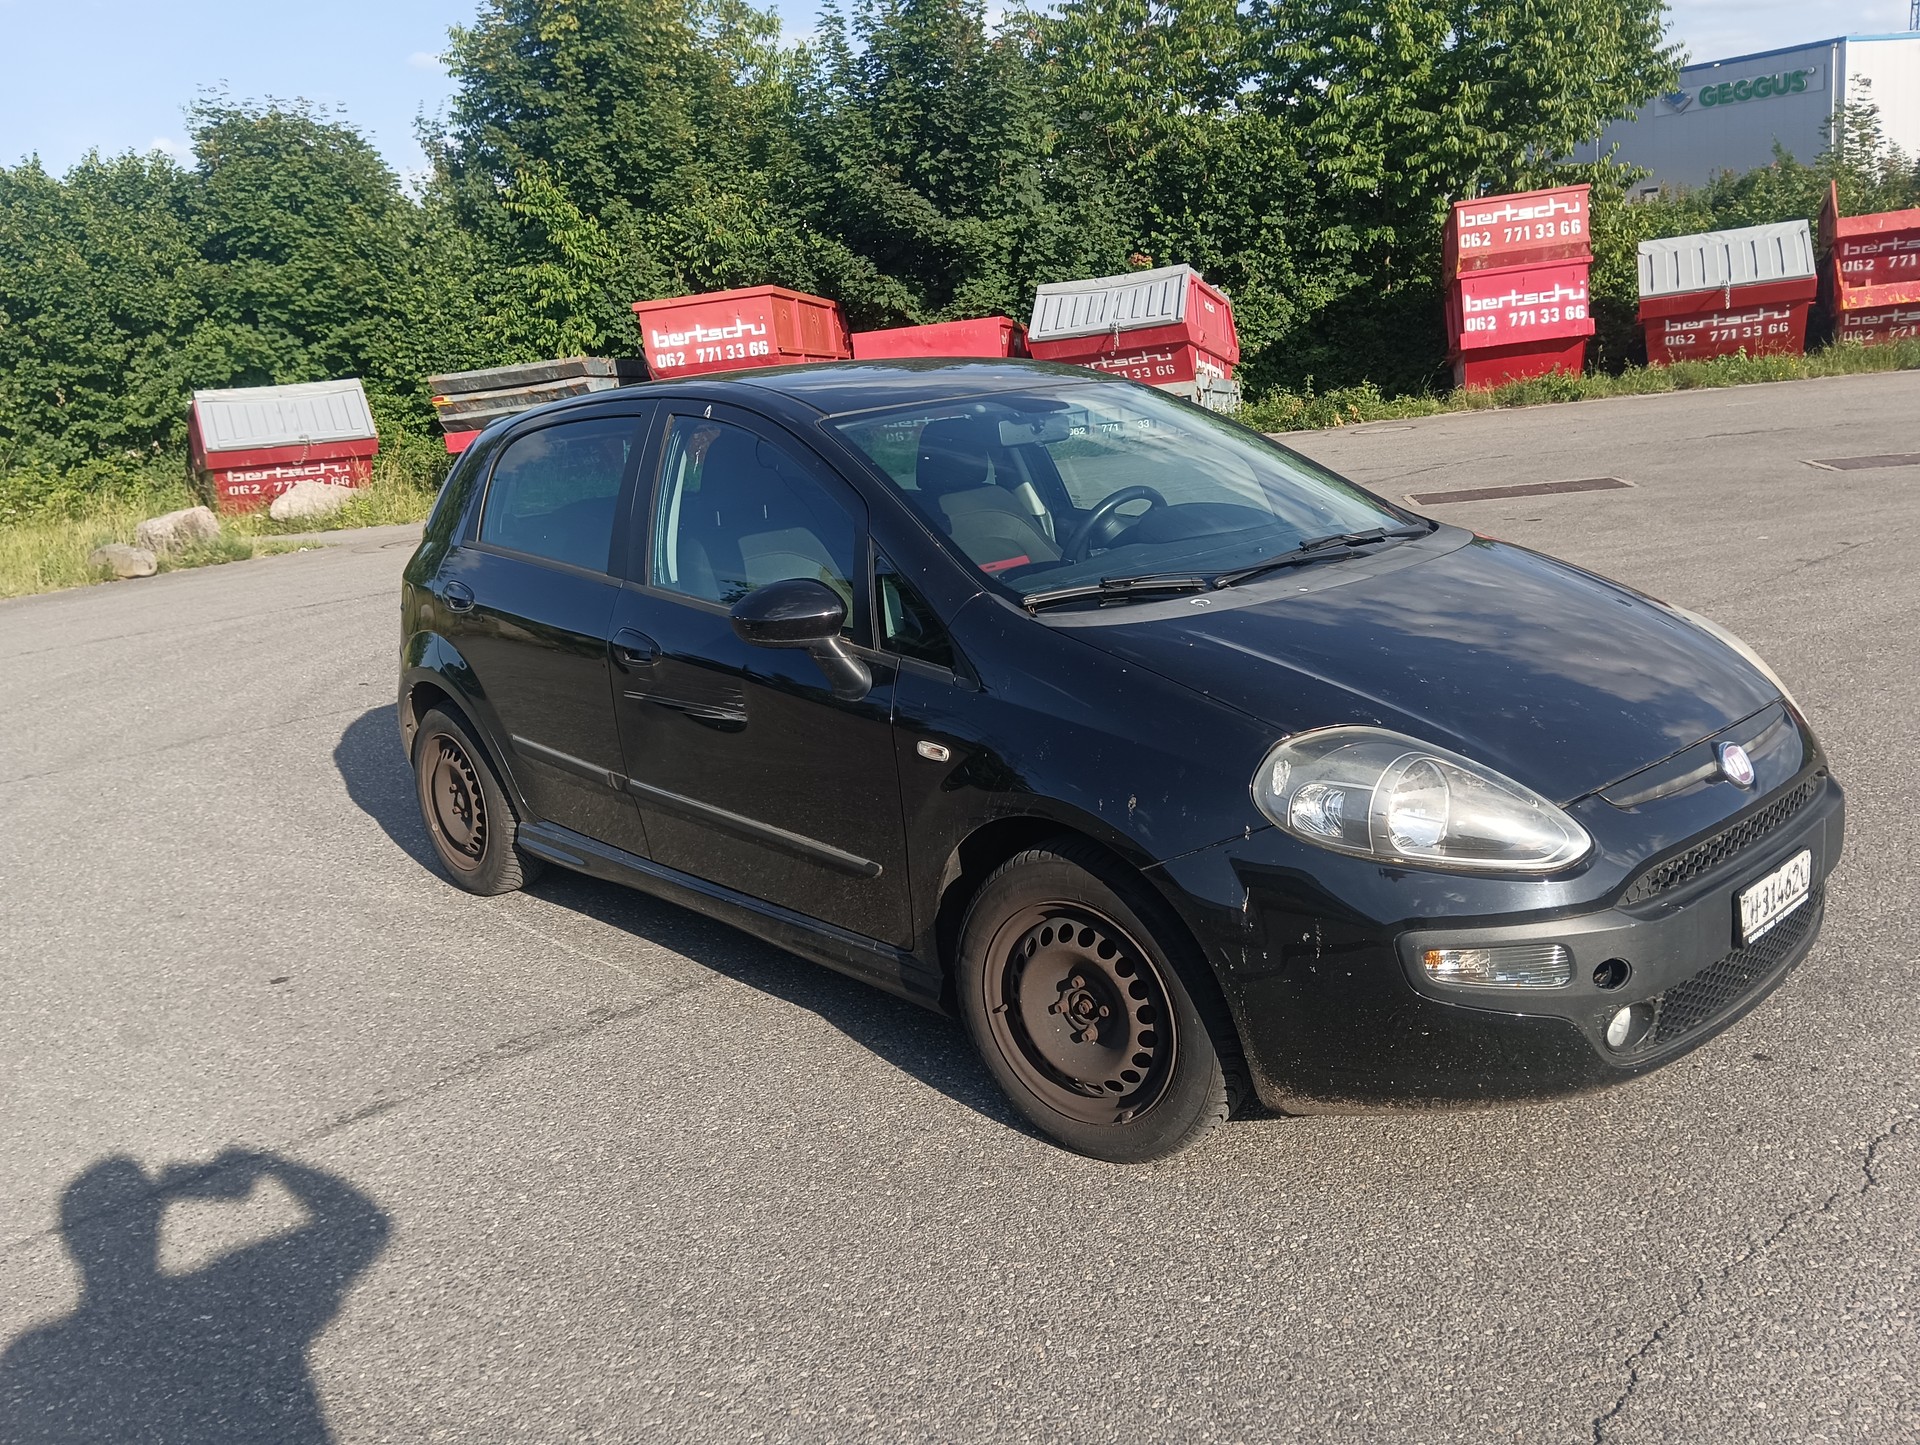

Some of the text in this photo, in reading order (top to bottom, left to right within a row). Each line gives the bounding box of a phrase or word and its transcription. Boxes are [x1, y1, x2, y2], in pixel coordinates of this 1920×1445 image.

[1699, 70, 1808, 107] GEGGUS
[1459, 193, 1581, 228] bertschi
[1460, 219, 1581, 248] 062 771 33 66
[1842, 253, 1917, 272] 062 771
[1465, 280, 1585, 312] bertschi
[652, 315, 767, 348] bertschi
[1466, 305, 1585, 332] 062 771 33 66
[1665, 304, 1790, 332] bertschi
[1664, 322, 1789, 346] 062 771 33 66
[1843, 329, 1874, 341] 062
[656, 340, 769, 368] 062 771 33 66
[1132, 367, 1151, 379] 33
[1156, 364, 1175, 376] 66
[1101, 423, 1119, 433] 771
[1137, 419, 1150, 429] 33
[228, 485, 261, 496] 062
